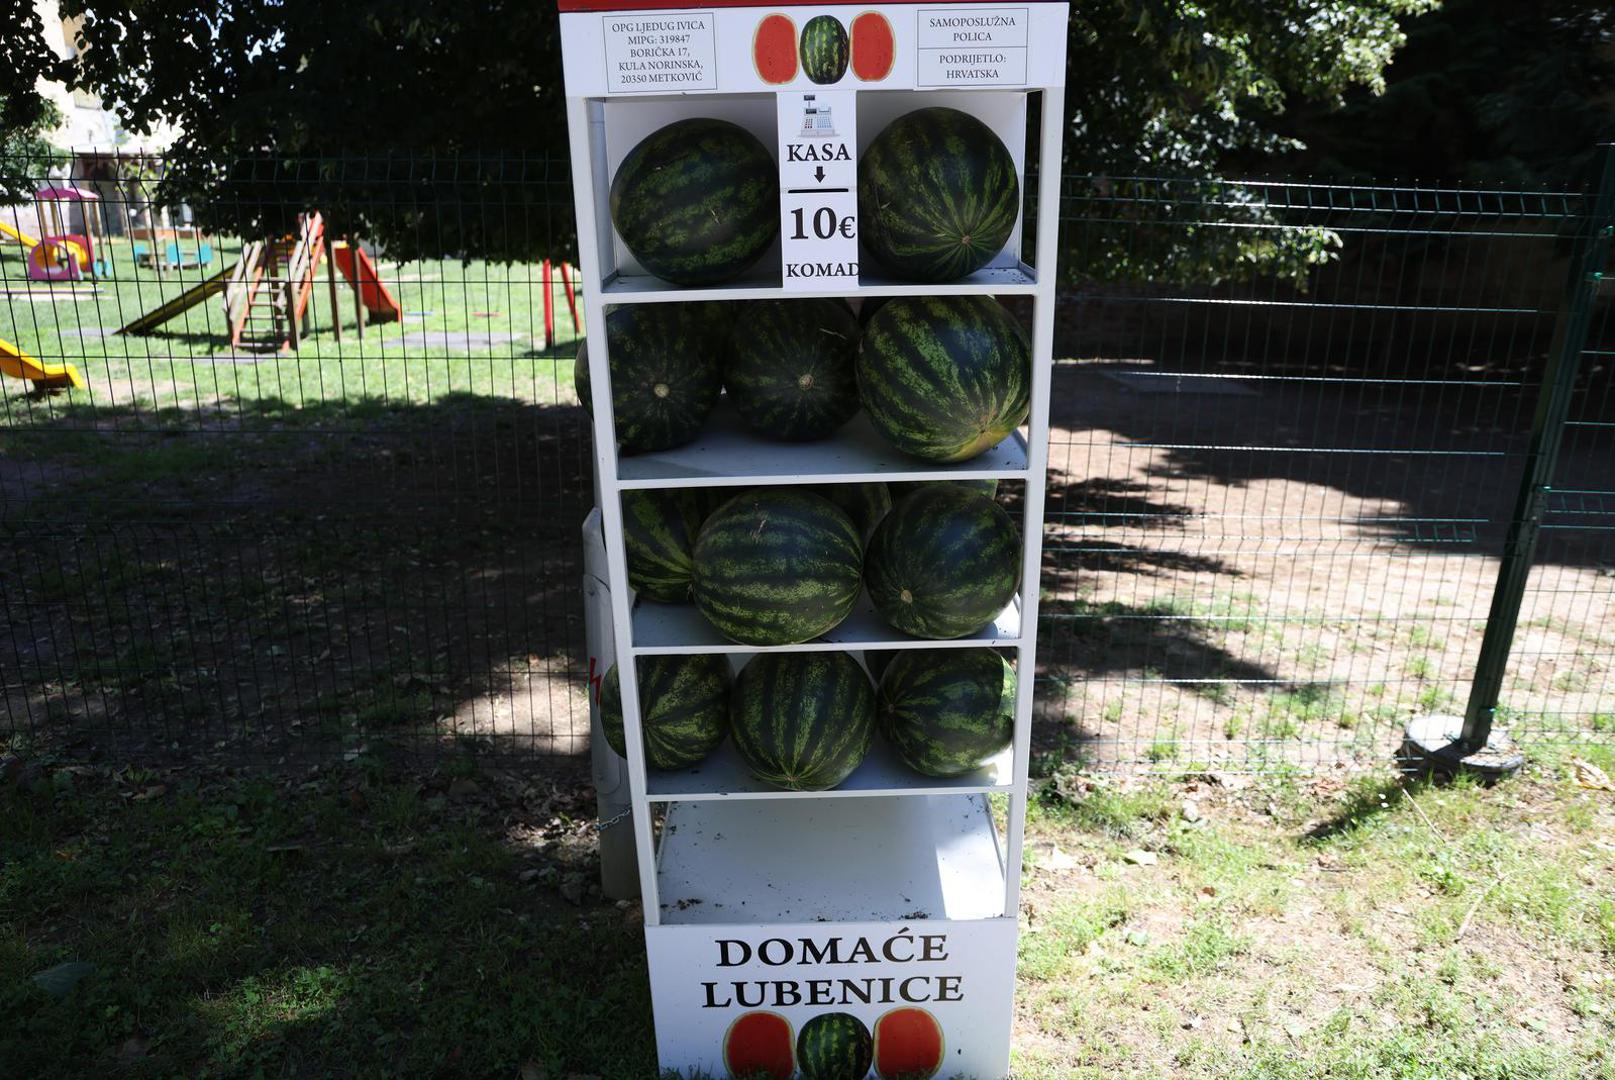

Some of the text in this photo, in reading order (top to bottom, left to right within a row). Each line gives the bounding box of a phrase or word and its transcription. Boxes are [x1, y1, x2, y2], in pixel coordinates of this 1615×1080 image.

[612, 20, 705, 34] OPG LJEDUG IVICA
[929, 16, 1016, 28] SAMOPOSLUŽNA
[628, 34, 691, 45] MIPG: 319847
[953, 32, 993, 42] POLICA
[630, 46, 690, 58] BORIČKA 17,
[619, 60, 704, 71] KULA NORINSKA,
[939, 54, 1007, 65] PODRIJETLO:
[621, 71, 703, 84] 20350 METKOVIĆ
[946, 69, 999, 79] HRVATSKA
[787, 143, 852, 162] KASA
[790, 206, 856, 240] 10€
[786, 263, 860, 278] KOMAD
[714, 926, 949, 967] DOMAĆE
[701, 975, 964, 1008] LUBENICE
